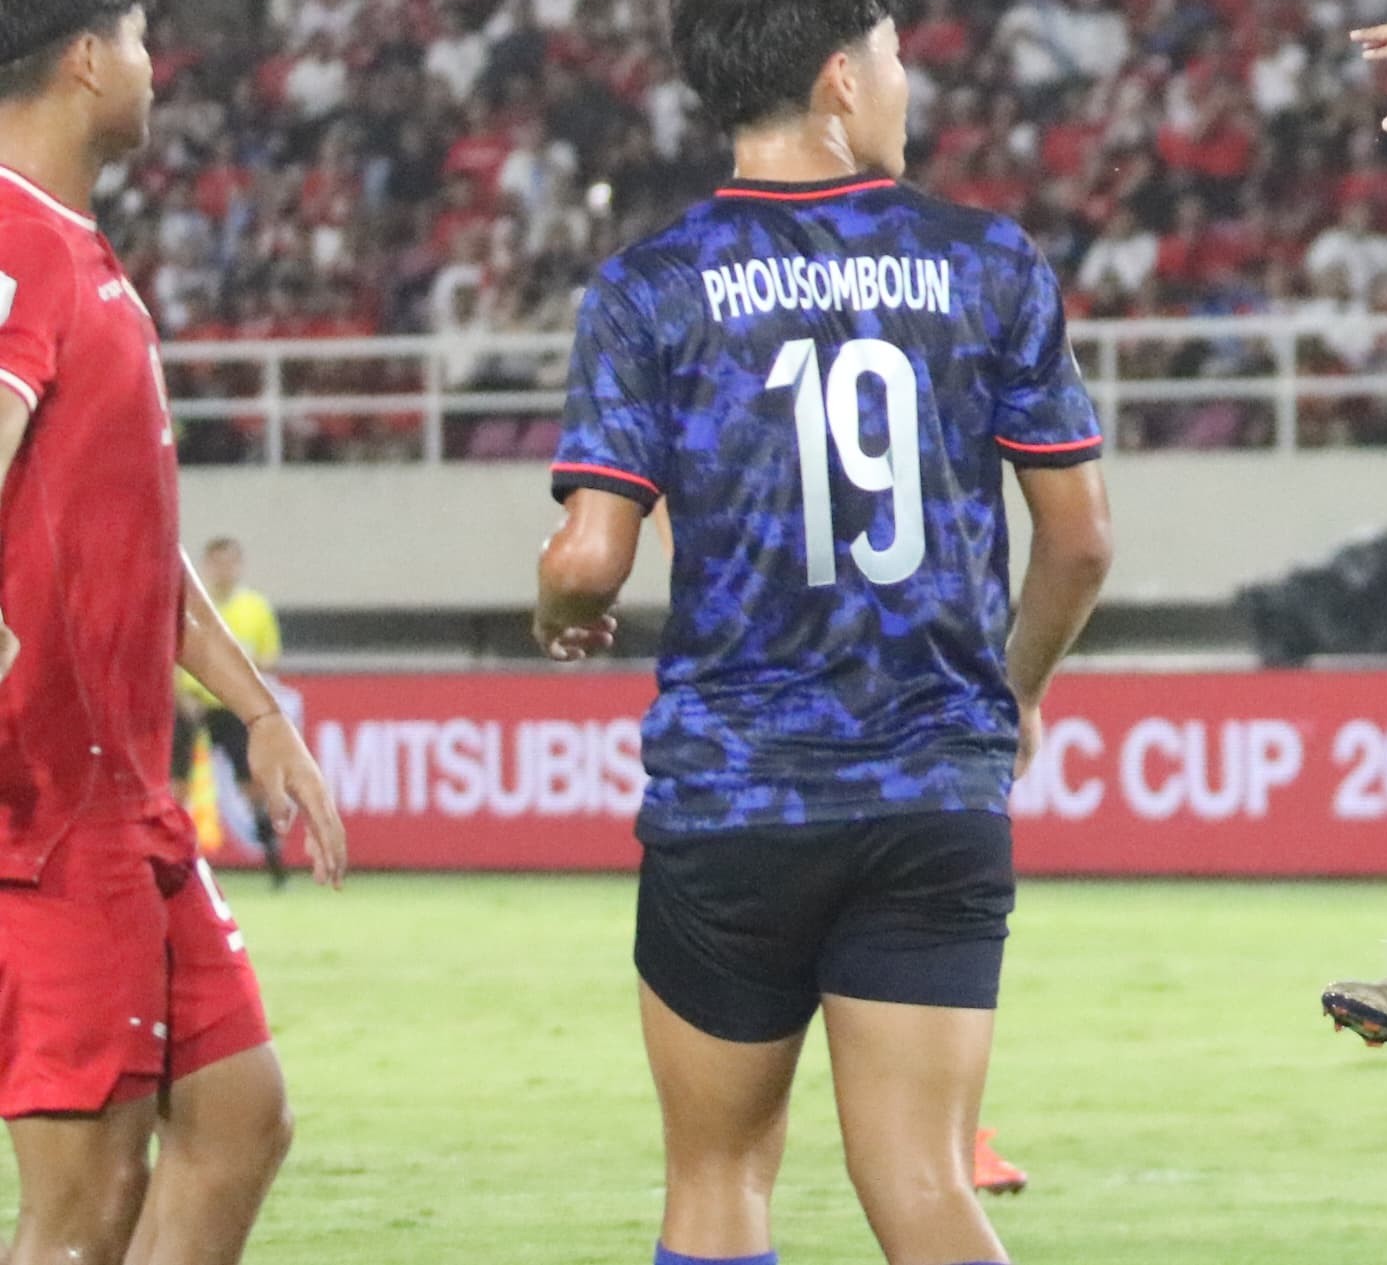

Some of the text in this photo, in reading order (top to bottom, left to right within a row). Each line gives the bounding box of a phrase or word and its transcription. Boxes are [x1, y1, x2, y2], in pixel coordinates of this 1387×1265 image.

[702, 255, 950, 322] PHOUSOMBOUN
[765, 338, 925, 586] 19
[1119, 716, 1304, 820] CUP
